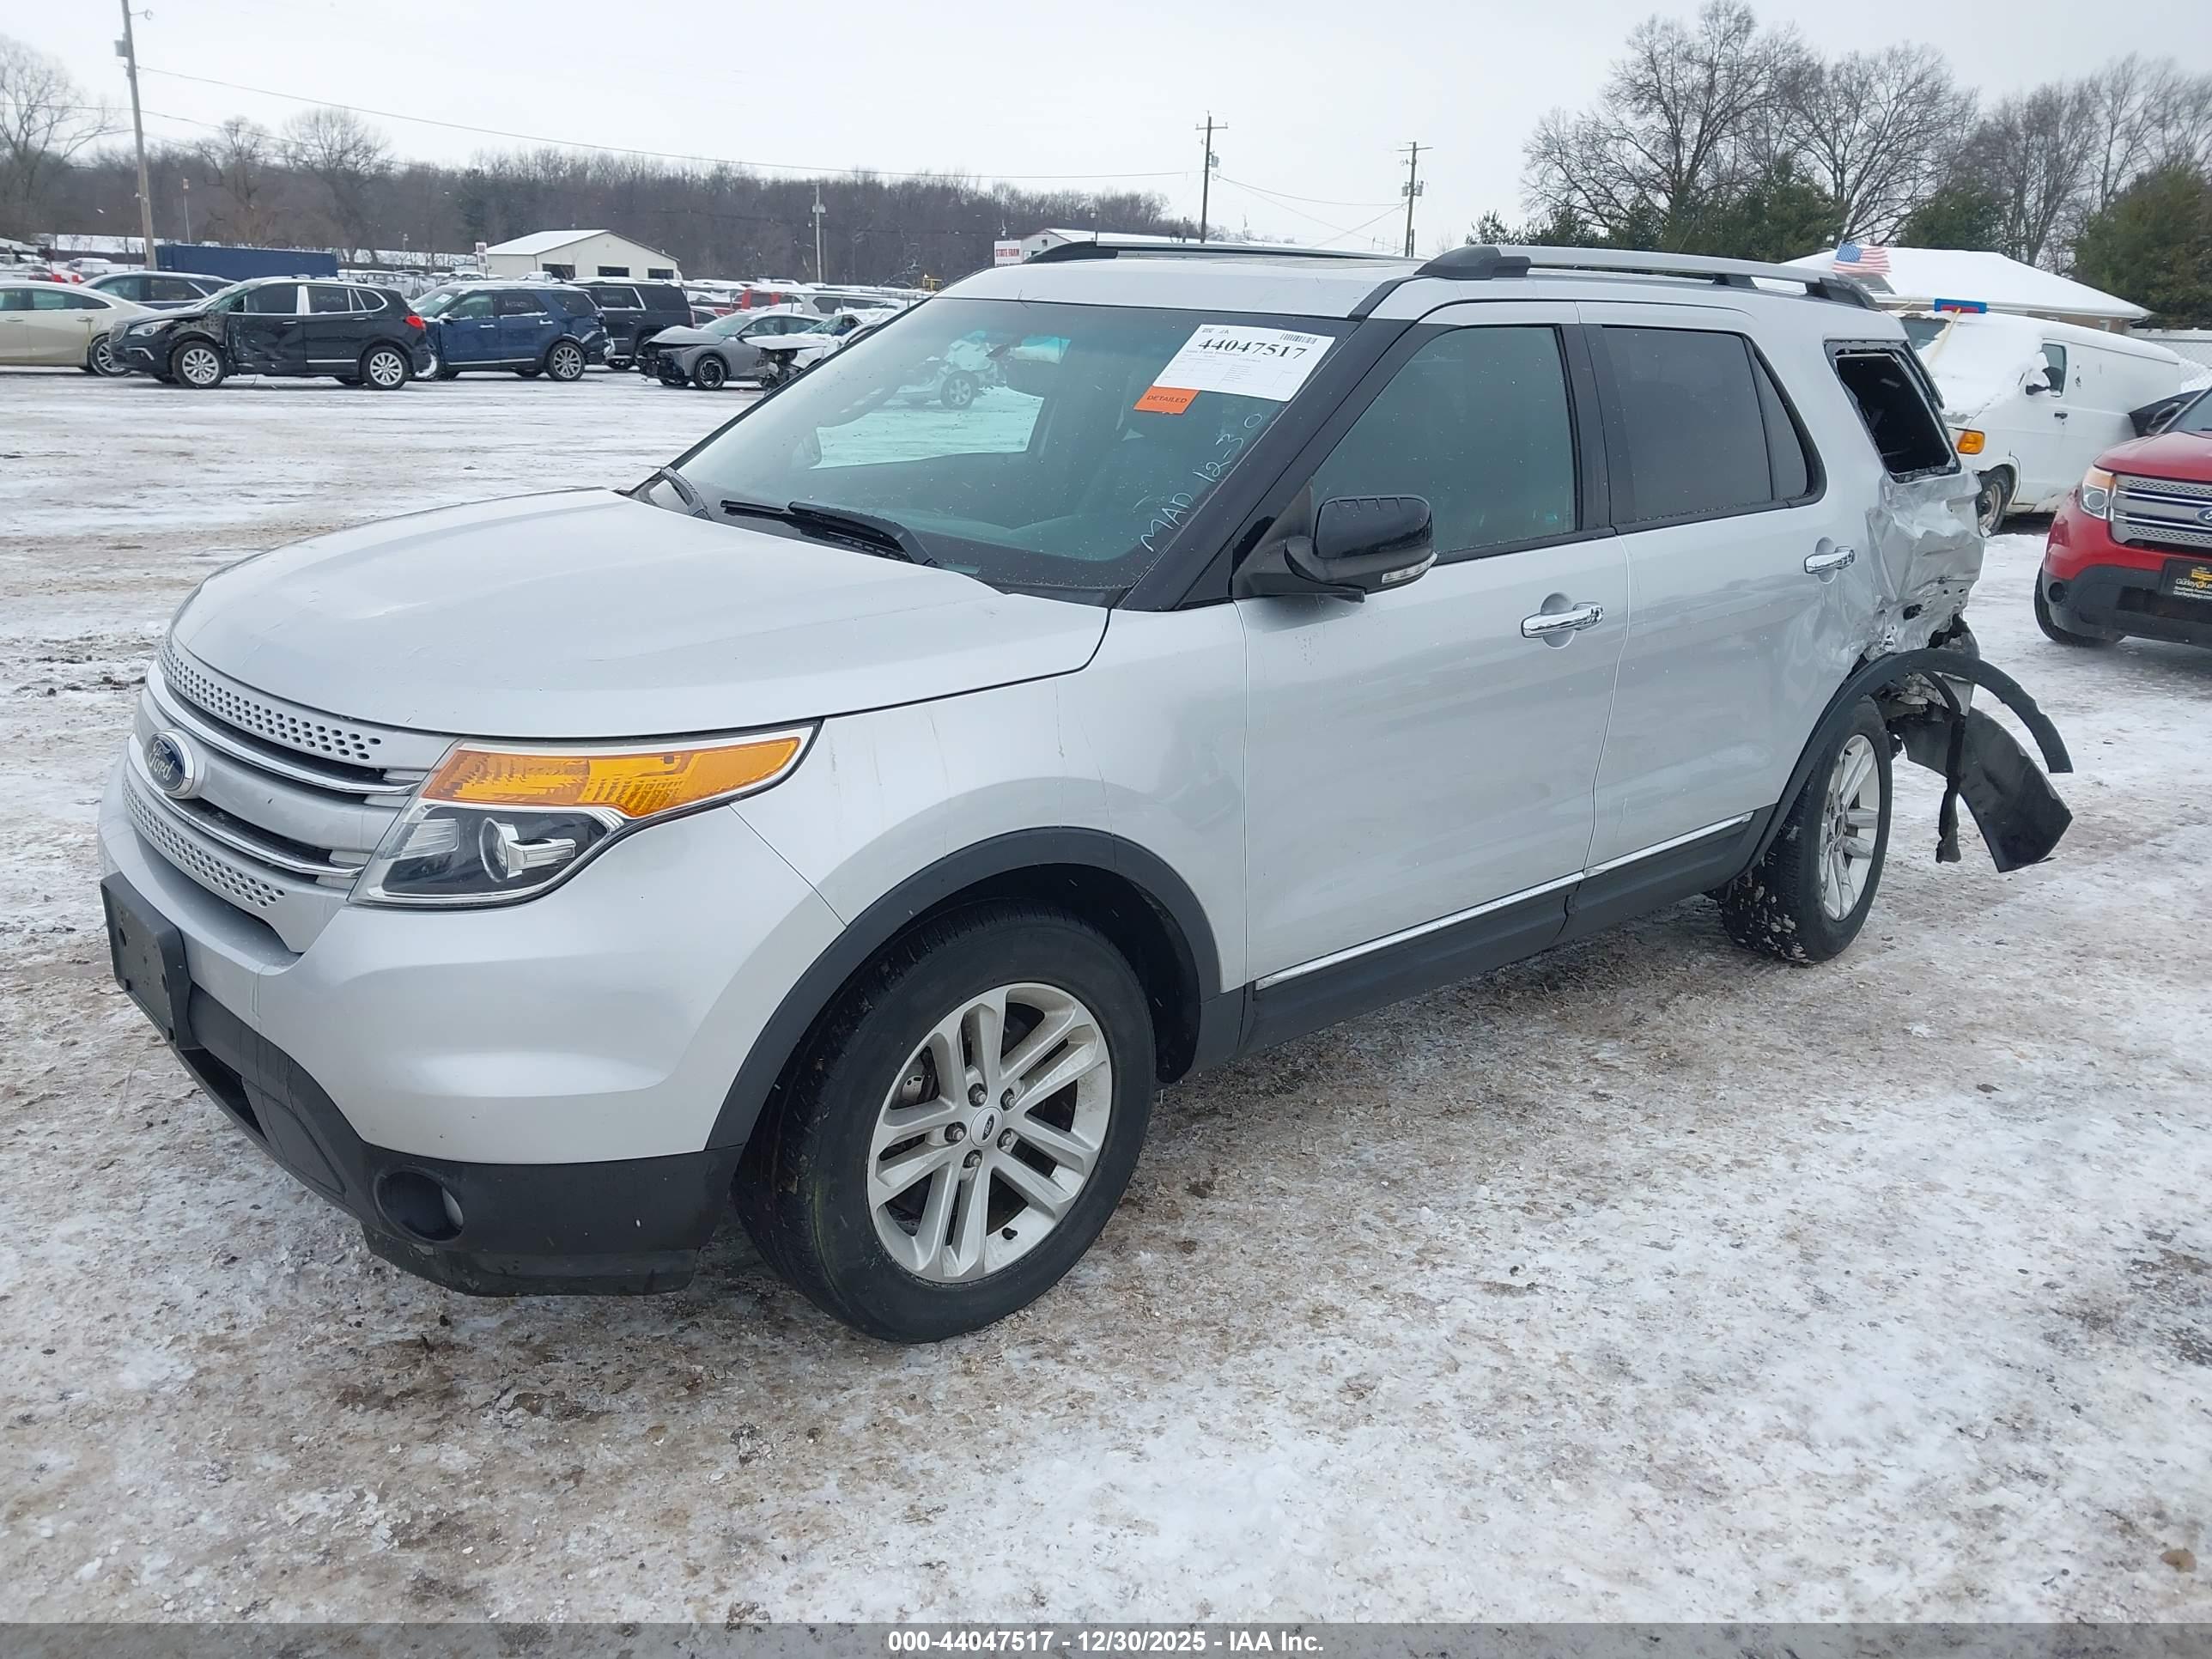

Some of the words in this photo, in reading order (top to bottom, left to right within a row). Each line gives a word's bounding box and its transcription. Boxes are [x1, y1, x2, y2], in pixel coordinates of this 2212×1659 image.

[1198, 337, 1308, 360] 44047517
[1146, 394, 1188, 404] DETAILED
[148, 739, 175, 781] Ford
